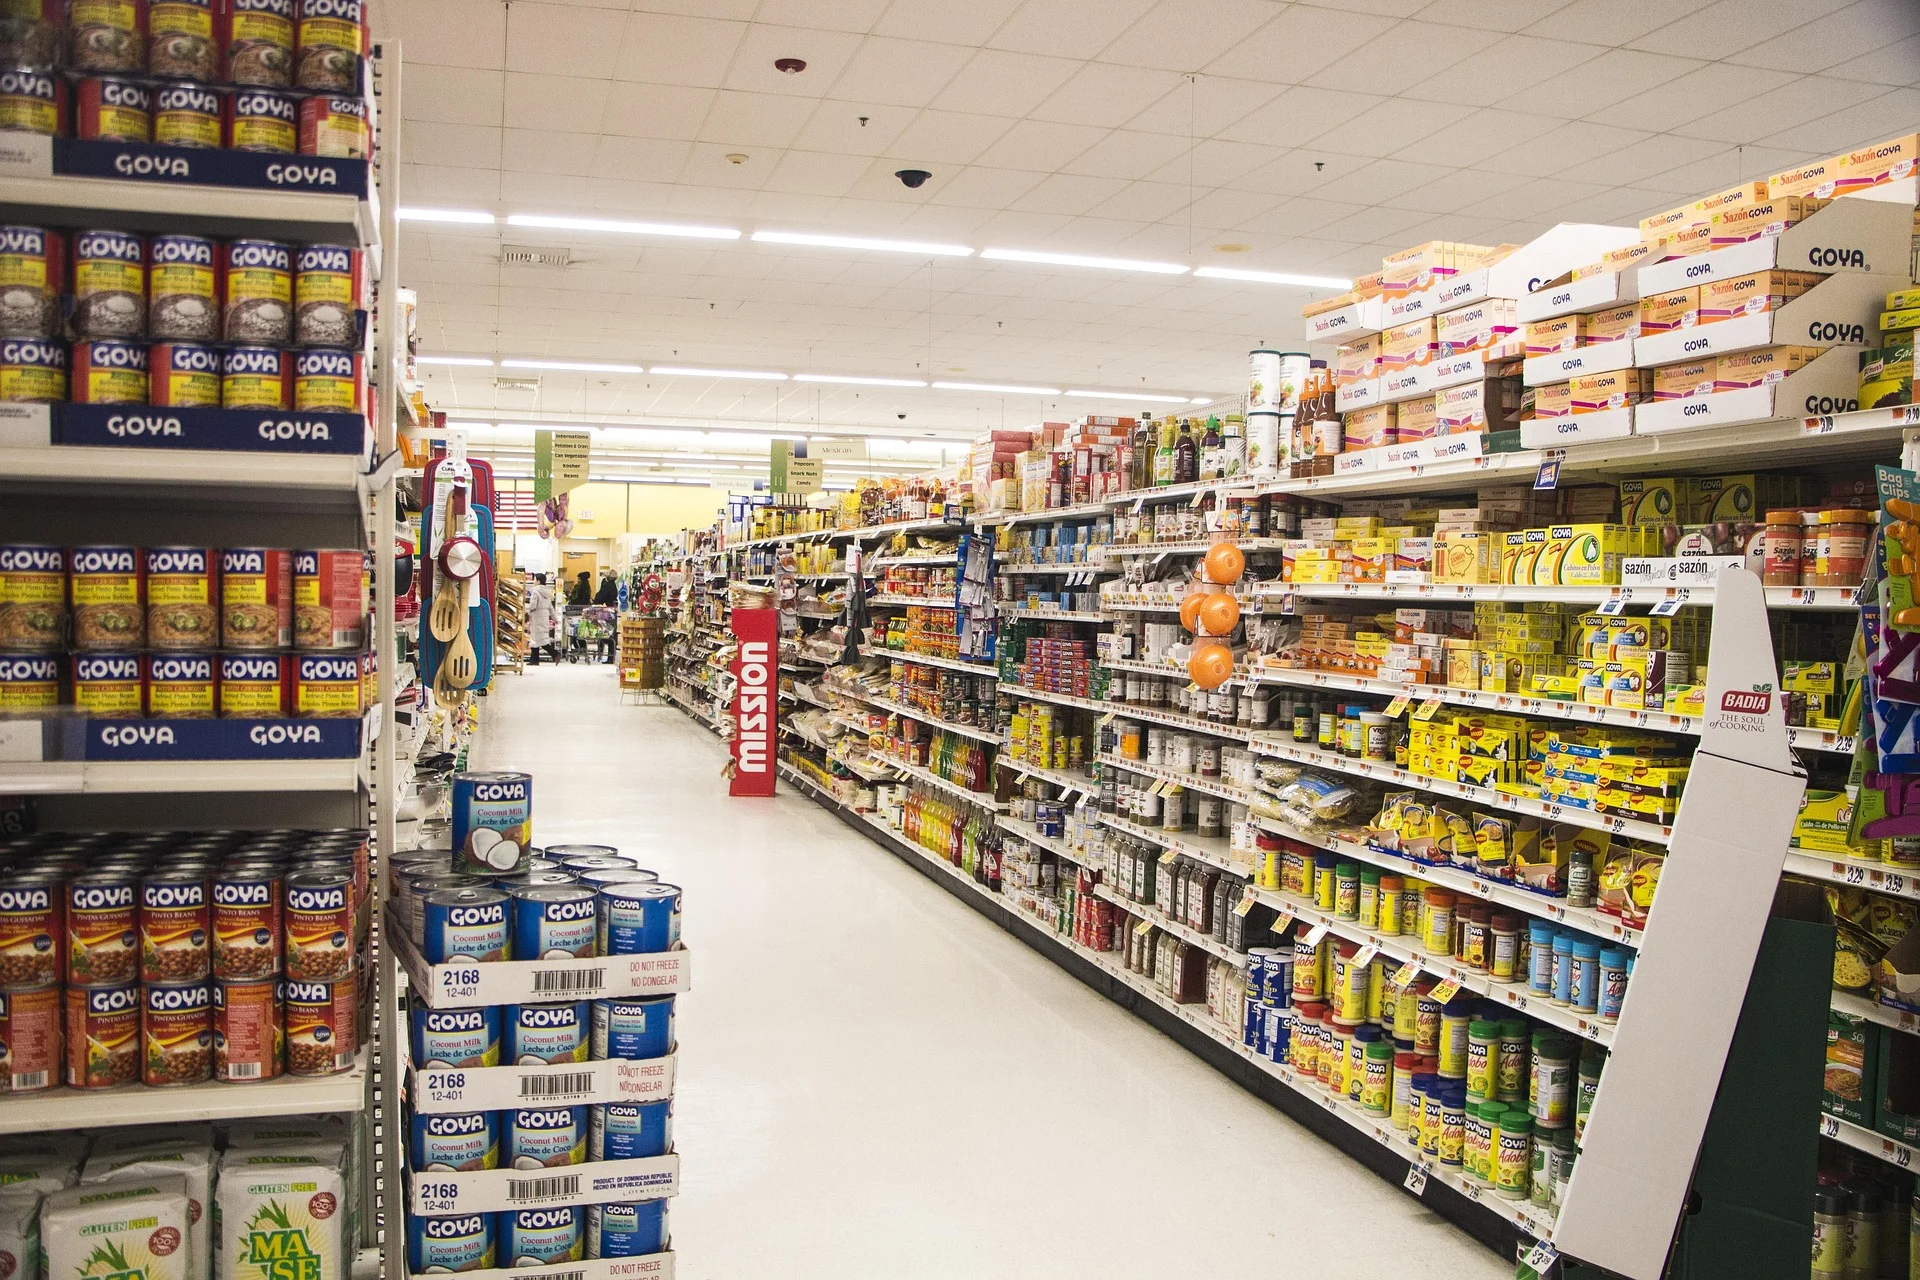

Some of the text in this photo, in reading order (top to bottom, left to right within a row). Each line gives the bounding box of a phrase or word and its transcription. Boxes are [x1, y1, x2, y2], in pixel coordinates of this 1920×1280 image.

[159, 90, 218, 115] GOYA
[237, 95, 296, 121] GOYA
[1850, 144, 1901, 165] Sazón GOYA
[115, 153, 189, 177] GOYA
[266, 163, 337, 187] GOYA
[1780, 167, 1824, 185] Sazón GOYA
[1704, 192, 1742, 210] Sazón GOYA
[1723, 205, 1772, 224] Sazón GOYA
[152, 242, 211, 264] GOYA
[231, 246, 289, 268] GOYA
[1611, 247, 1648, 262] Sazón GOYA
[1809, 247, 1863, 267] GOYA
[1687, 263, 1710, 277] GOYA
[1712, 279, 1755, 296] Sazón GOYA
[1392, 300, 1422, 315] Sazón GOYA
[1552, 293, 1570, 305] GOYA
[1316, 316, 1346, 332] Sazón GOYA
[1534, 320, 1567, 335] Sazón GOYA
[1809, 322, 1864, 343] GOYA
[1684, 338, 1708, 351] GOYA
[1438, 360, 1471, 377] Sazón GOYA
[1562, 358, 1582, 370] GOYA
[1728, 354, 1773, 368] Sazón GOYA
[1579, 376, 1615, 390] Sazón GOYA
[1684, 404, 1708, 416] GOYA
[1805, 395, 1859, 414] GOYA
[107, 415, 182, 438] GOYA
[258, 419, 329, 441] GOYA
[537, 469, 549, 479] 10
[1879, 470, 1902, 488] Bag
[1881, 483, 1910, 500] Clips
[1526, 531, 1544, 541] GOYA
[1552, 528, 1572, 538] GOYA
[74, 552, 134, 573] GOYA
[1625, 560, 1651, 576] sazón
[1678, 558, 1708, 574] sazón
[1586, 617, 1602, 626] GOYA
[1611, 619, 1626, 627] GOYA
[78, 660, 138, 680] GOYA
[152, 660, 210, 680] GOYA
[302, 660, 357, 680] GOYA
[1606, 663, 1621, 671] GOYA
[739, 642, 768, 772] mission
[1725, 693, 1767, 710] BADIA
[1709, 720, 1765, 732] of COOKING
[1721, 714, 1765, 725] THE SOUL
[101, 726, 174, 747] GOYA
[250, 725, 320, 746] GOYA
[476, 784, 525, 800] GOYA
[478, 808, 523, 816] Coconut Milk
[478, 818, 497, 826] Leche
[510, 818, 524, 826] Coco
[74, 887, 133, 909] GOYA
[145, 886, 203, 907] GOYA
[289, 889, 343, 909] GOYA
[450, 906, 502, 924] GOYA
[548, 900, 595, 920] GOYA
[630, 959, 679, 972] DO NOT FREEZE
[443, 970, 480, 986] 2168
[631, 975, 678, 987] NO CONGELAR
[446, 987, 477, 997] 12-401
[522, 1009, 574, 1026] GOYA
[614, 1006, 642, 1016] GOYA
[428, 1013, 482, 1031] GOYA
[523, 1034, 573, 1044] Coconut Milk
[523, 1044, 575, 1053] Leche de Coco
[428, 1074, 465, 1089] 2168
[432, 1091, 462, 1101] 12-401
[517, 1110, 571, 1128] GOYA
[610, 1106, 637, 1116] GOYA
[430, 1115, 484, 1135] GOYA
[1500, 1137, 1526, 1148] GOYA
[1498, 1147, 1527, 1164] Adobo
[248, 1182, 317, 1194] GLUTEN FREE
[421, 1184, 458, 1198] 2168
[424, 1201, 455, 1210] 12-401
[79, 1217, 158, 1236] GLUTEN FREE
[428, 1217, 482, 1237] GOYA
[519, 1210, 571, 1228] GOYA
[254, 1235, 306, 1259] MA
[272, 1258, 318, 1280] SE
